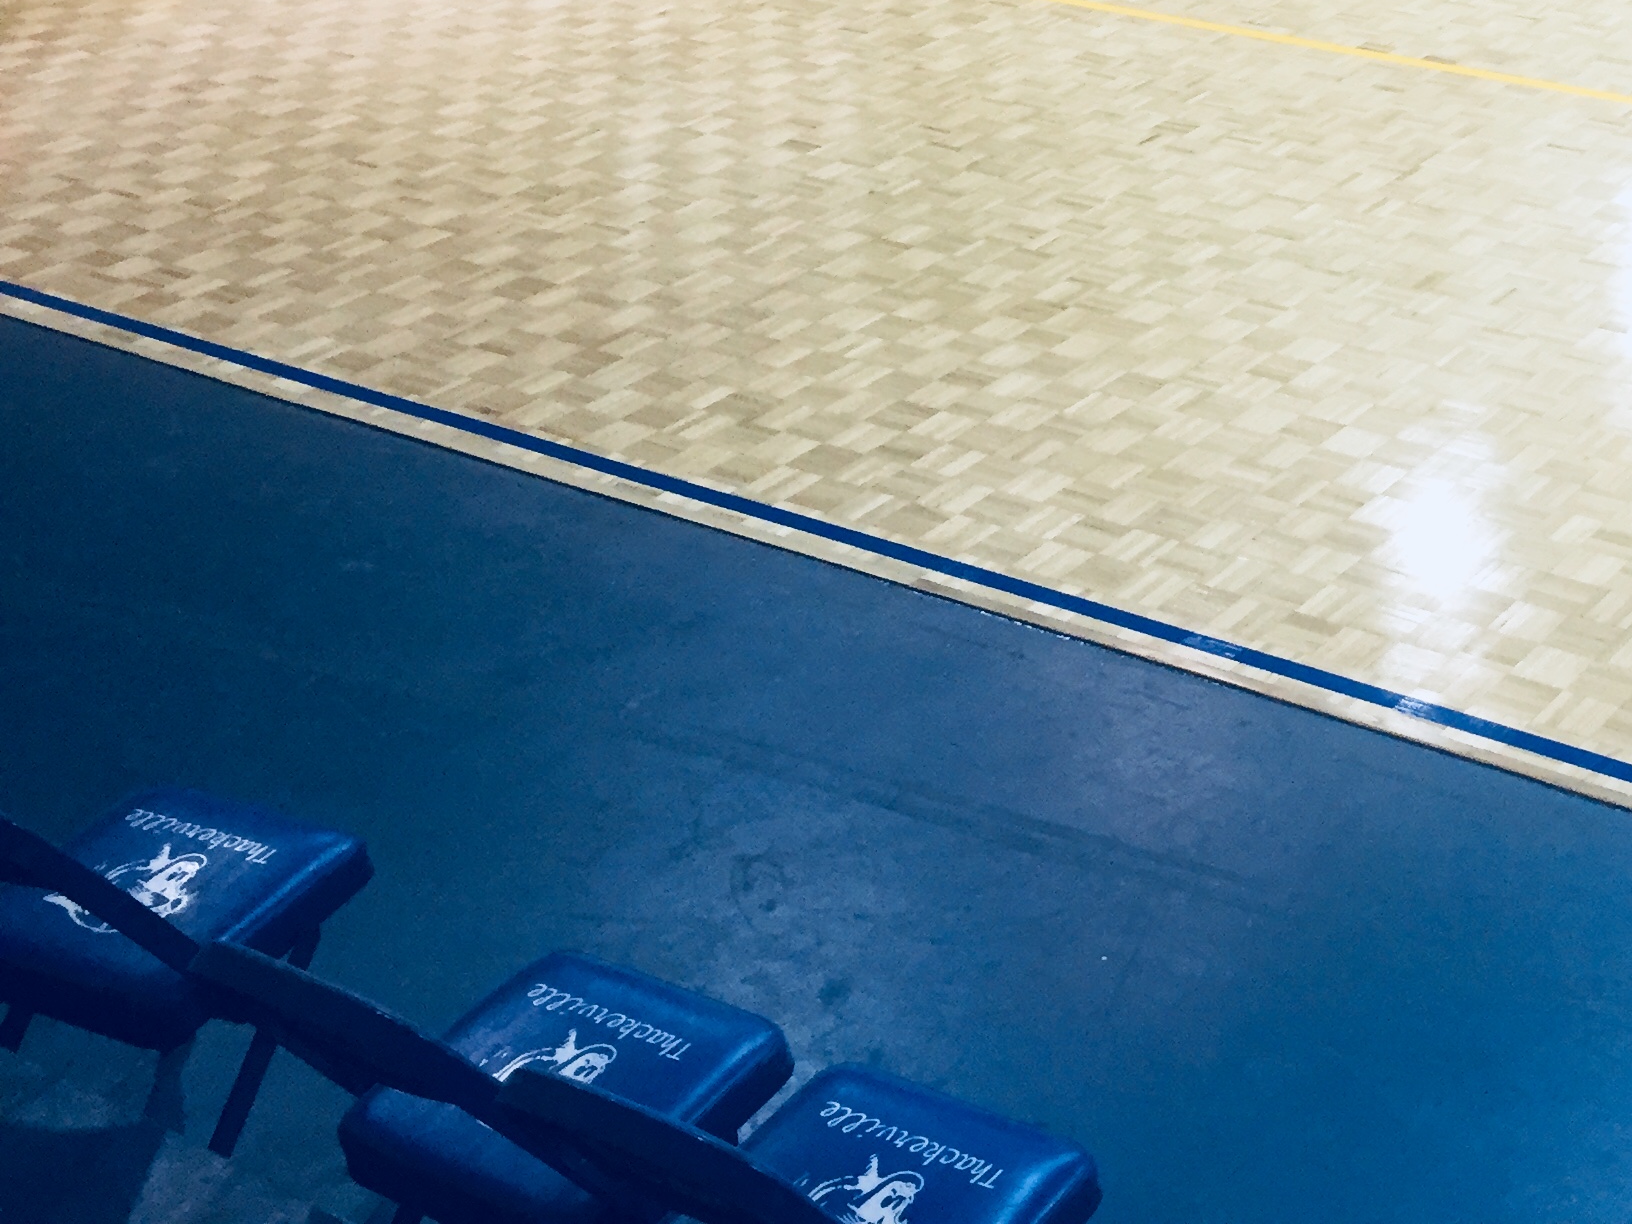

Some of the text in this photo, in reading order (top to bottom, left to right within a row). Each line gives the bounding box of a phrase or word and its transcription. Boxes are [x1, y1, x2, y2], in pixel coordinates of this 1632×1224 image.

[125, 808, 277, 864] Thackerville
[527, 983, 691, 1061] Thackerville
[820, 1101, 1004, 1189] Thackerville
